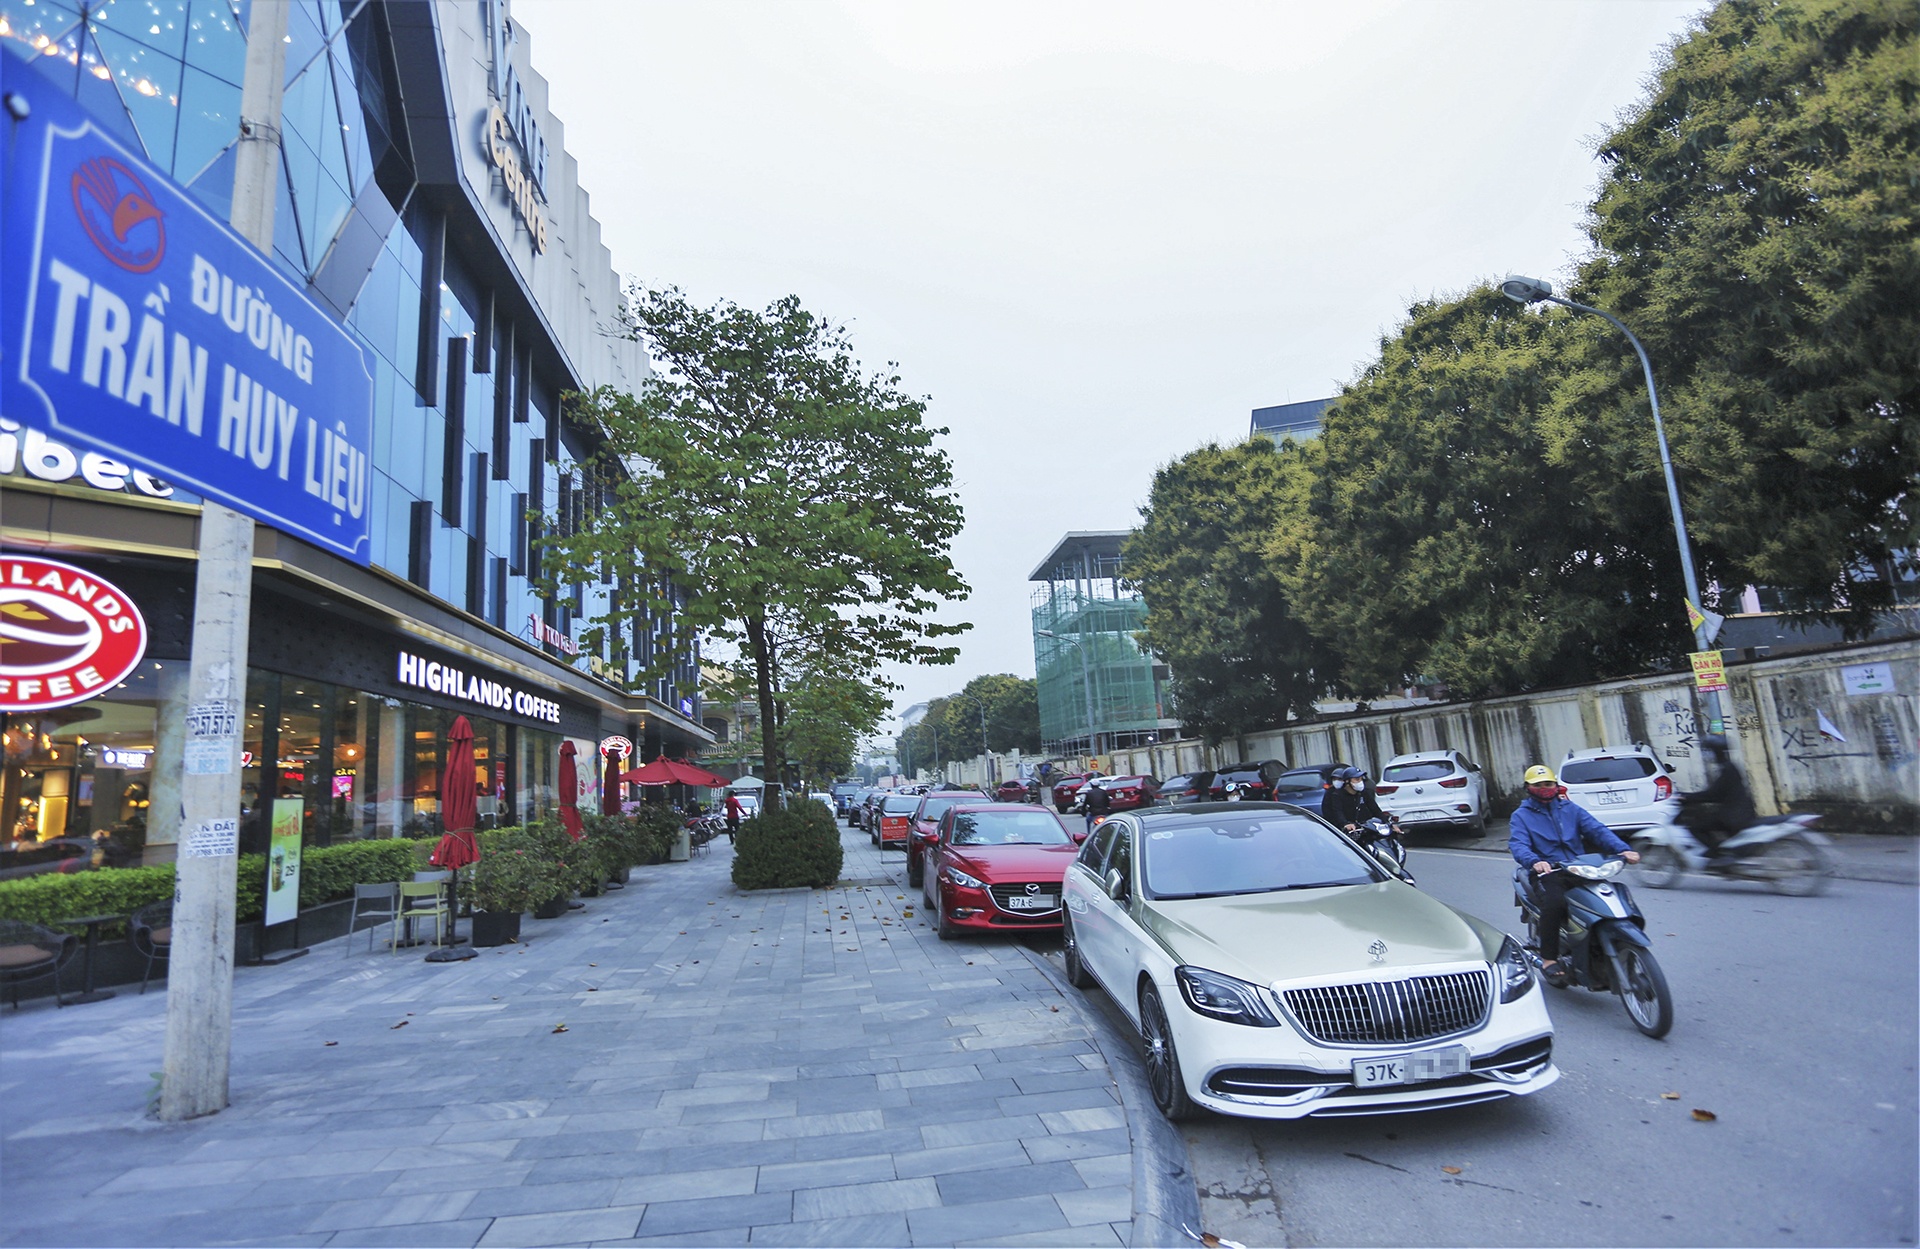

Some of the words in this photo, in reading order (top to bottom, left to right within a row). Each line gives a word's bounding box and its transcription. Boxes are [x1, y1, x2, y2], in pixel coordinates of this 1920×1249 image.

[488, 105, 547, 256] Centre
[191, 253, 314, 385] ĐƯỜNG
[50, 257, 209, 437] TRẦN
[218, 362, 299, 481] HUY
[305, 419, 366, 526] LIỆU
[0, 565, 134, 634] LANDS
[399, 651, 512, 711] HIGHLANDS
[514, 690, 560, 723] COFFEE
[1781, 726, 1819, 749] XE
